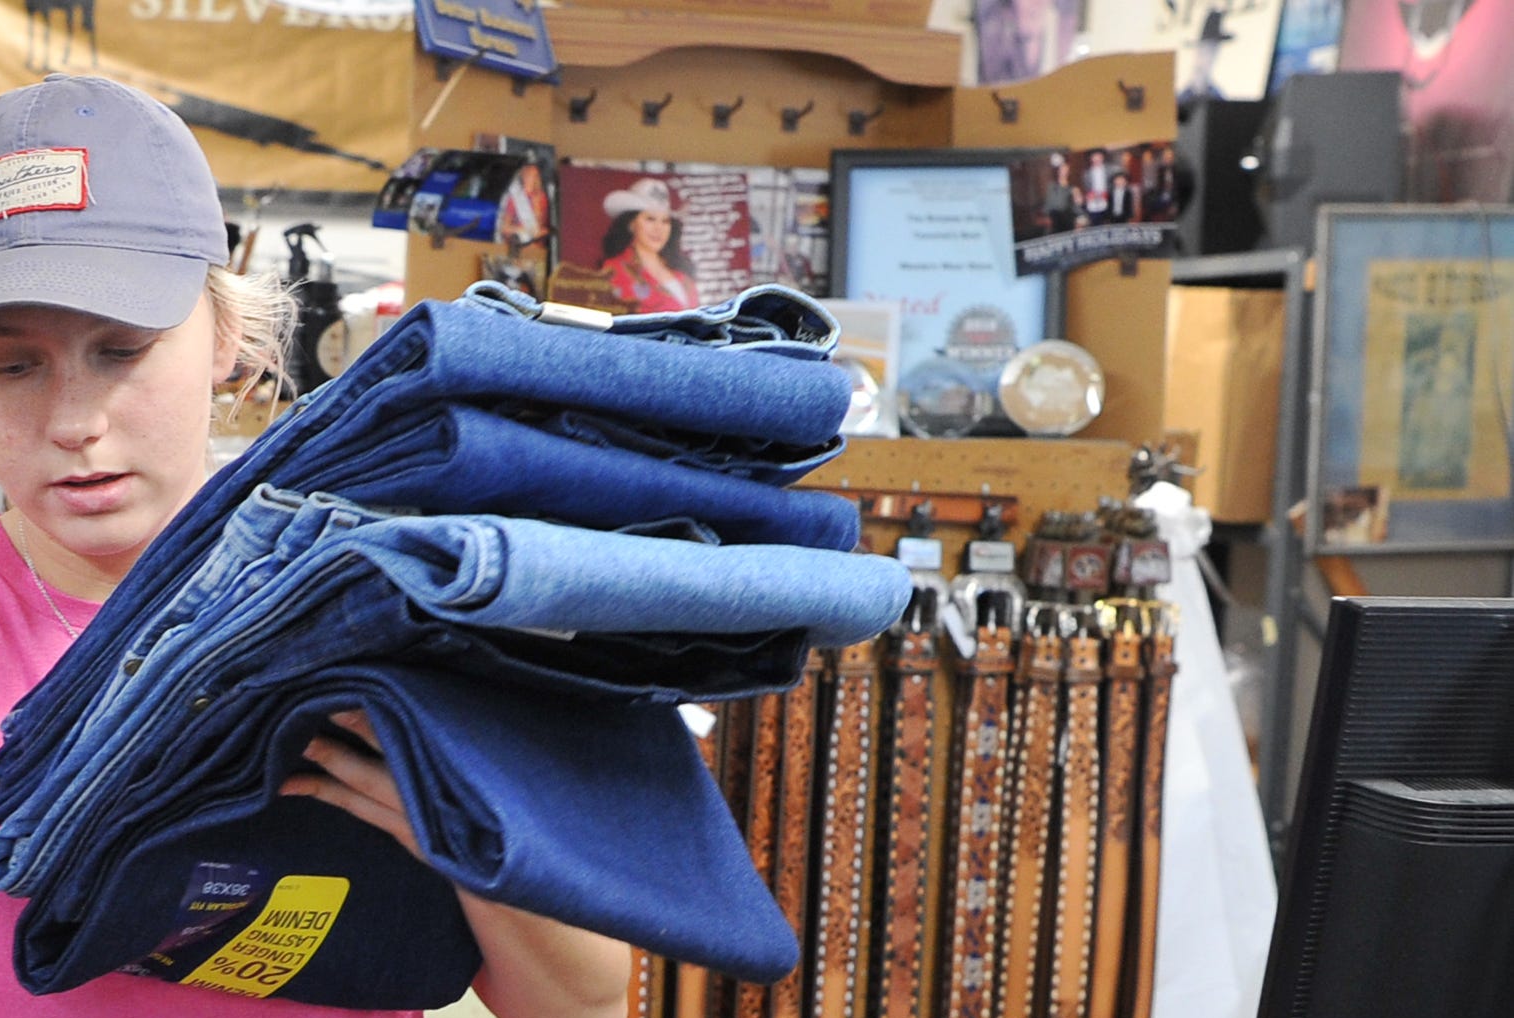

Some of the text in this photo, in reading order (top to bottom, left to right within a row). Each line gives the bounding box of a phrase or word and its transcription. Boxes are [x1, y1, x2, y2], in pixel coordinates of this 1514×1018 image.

[262, 909, 332, 930] DENIM
[246, 929, 320, 949] LASTING
[232, 940, 306, 966] LONGER
[210, 956, 294, 986] 20%
